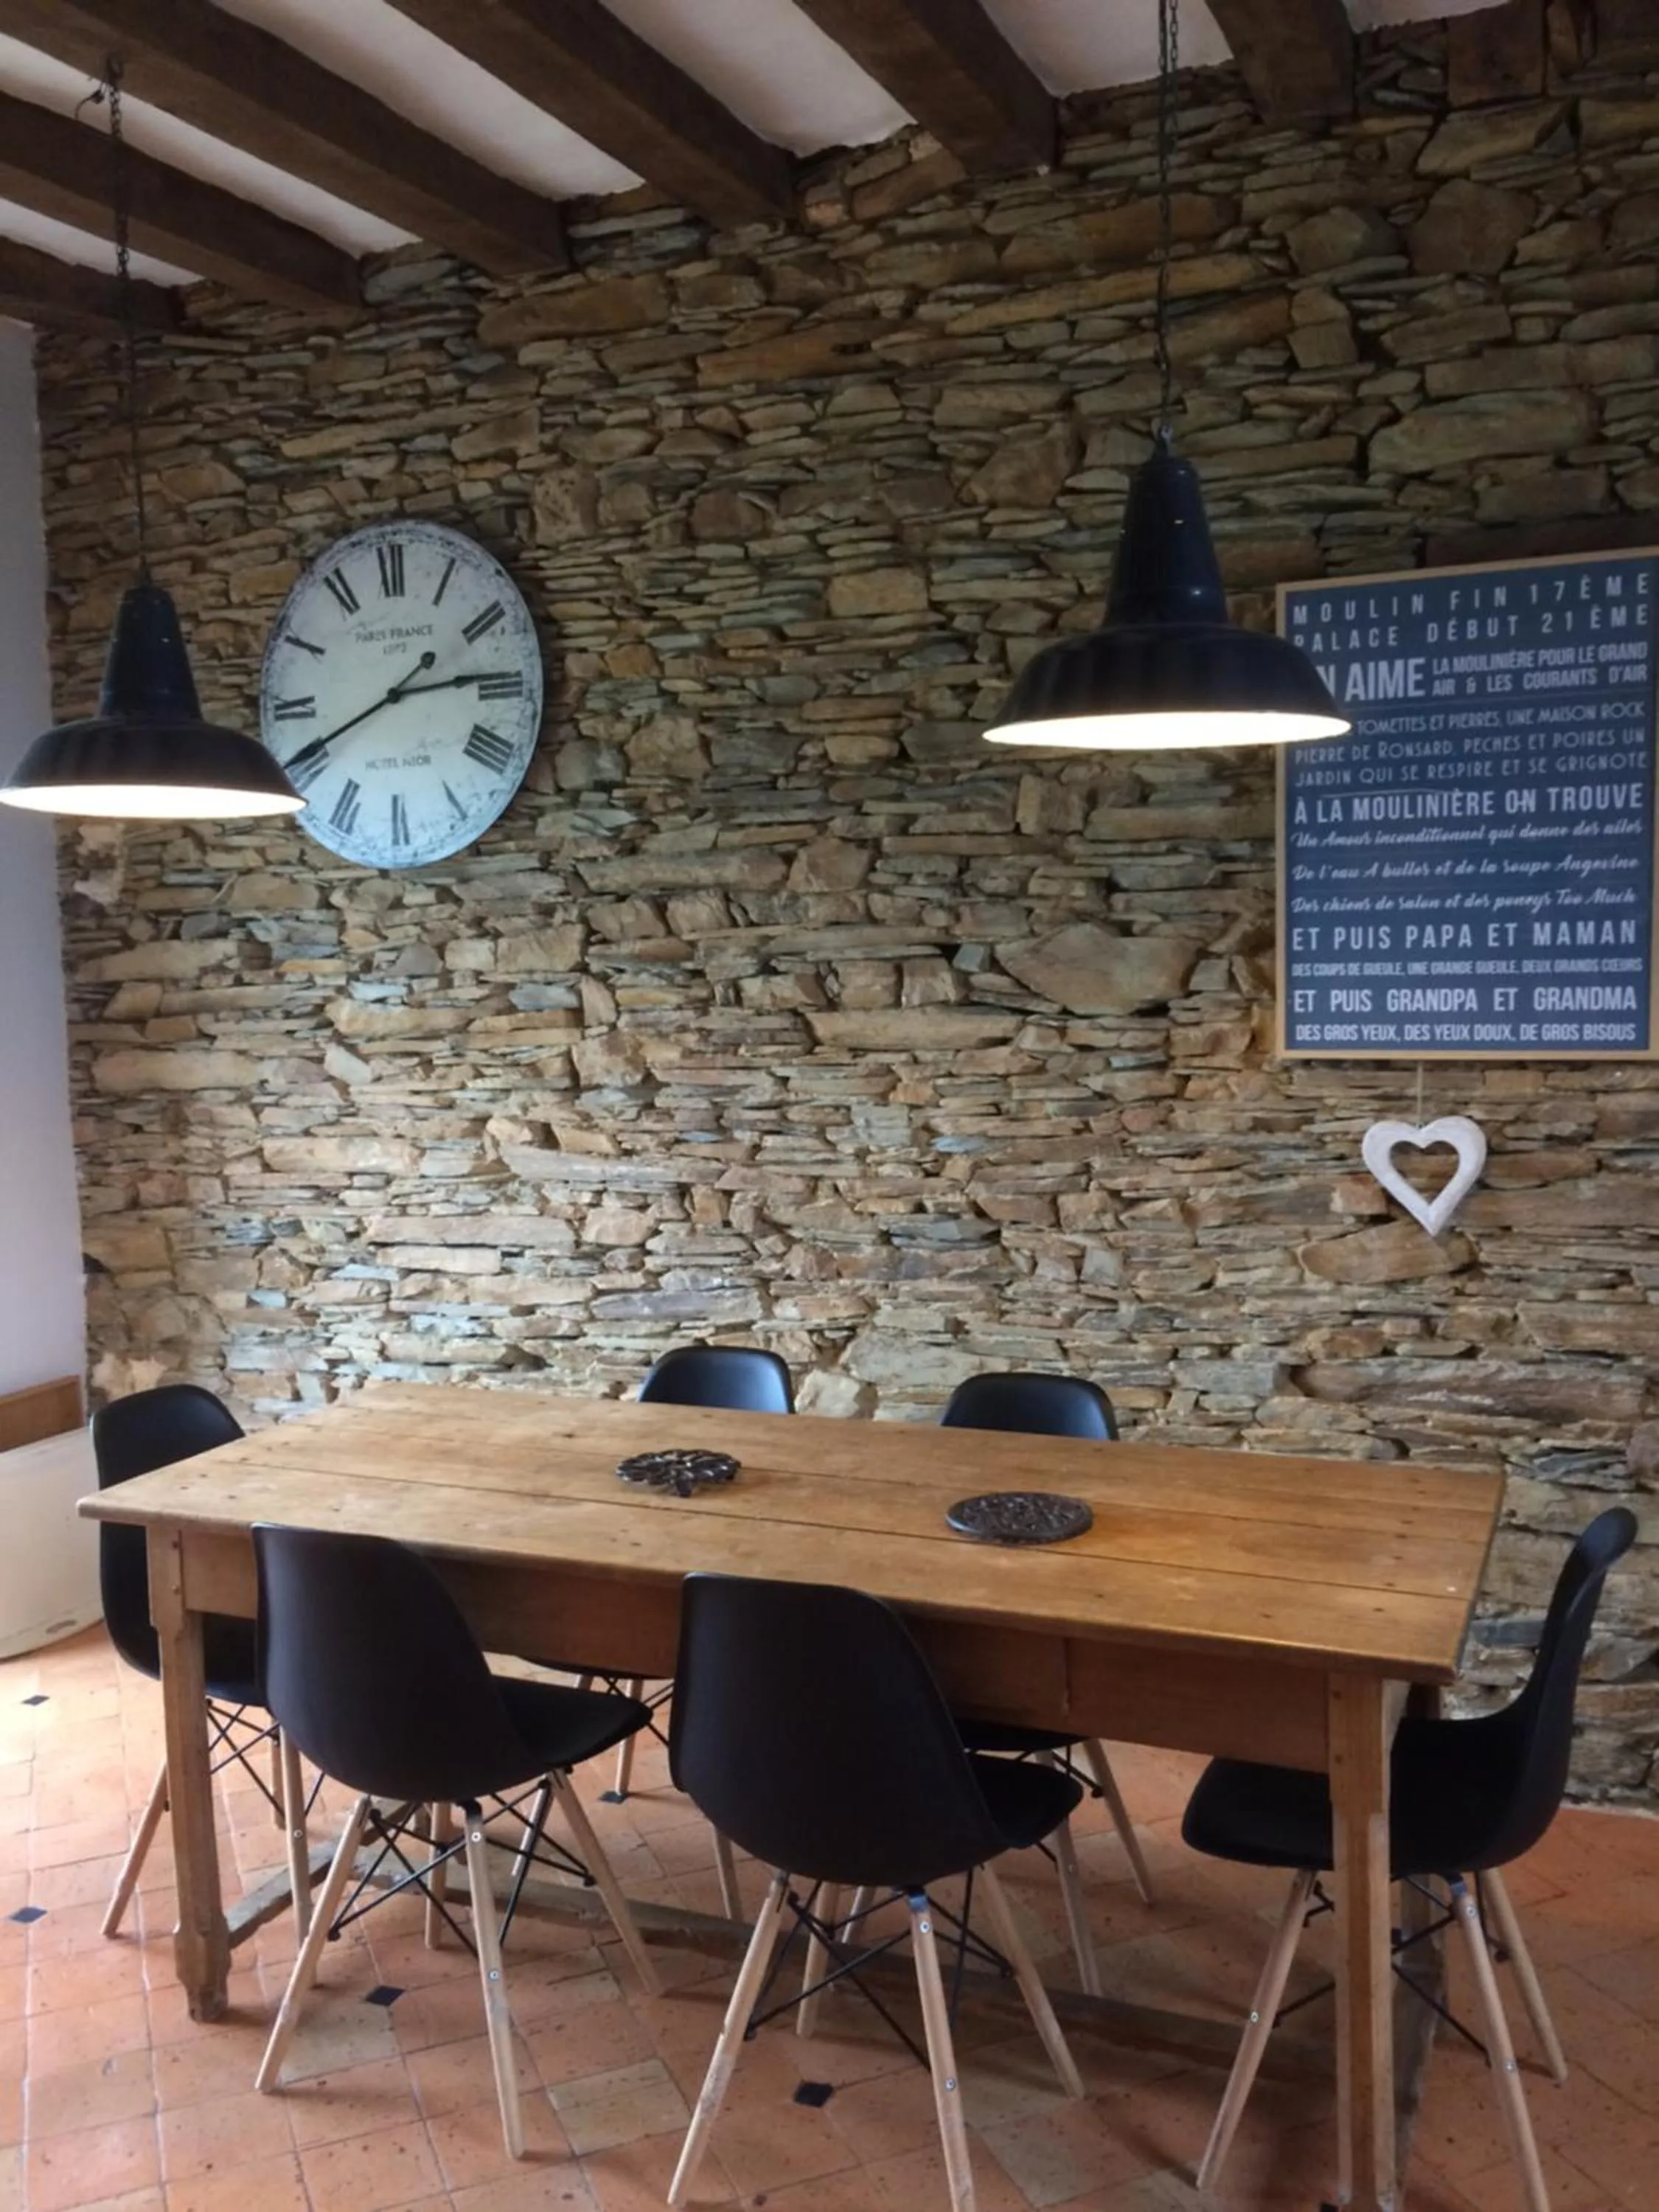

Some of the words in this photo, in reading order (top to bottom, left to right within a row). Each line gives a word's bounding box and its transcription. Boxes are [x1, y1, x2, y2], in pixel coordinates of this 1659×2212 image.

[1293, 593, 1424, 625] MOULIN
[1450, 586, 1506, 611] FIN
[1295, 625, 1399, 653] PALACE
[1427, 615, 1518, 643] DÉBUT
[1433, 657, 1450, 675] LA
[1538, 647, 1576, 667] POUR
[1579, 645, 1596, 664] LE
[1598, 641, 1648, 662] GRAND
[1344, 658, 1426, 702] AIME
[1433, 678, 1455, 696] AIR
[1466, 676, 1477, 695] &
[1486, 673, 1512, 692] LES
[1523, 667, 1598, 690] COURANTS
[1608, 664, 1648, 684] D'AIR
[1357, 716, 1427, 734] TOMETTES
[1430, 714, 1445, 731] ET
[1506, 708, 1534, 726] UNE
[1537, 706, 1596, 723] MAISON
[1601, 701, 1646, 720] ROCK
[1295, 746, 1346, 765] PIERRE
[1352, 744, 1371, 762] DE
[1528, 733, 1546, 751] ET
[1552, 729, 1616, 748] POIRES
[1623, 727, 1645, 745] UN
[1295, 769, 1352, 787] JARDIN
[1359, 765, 1393, 785] QUI
[1402, 764, 1420, 782] SE
[1427, 760, 1493, 779] RESPIRE
[1501, 759, 1520, 776] ET
[1528, 757, 1548, 775] SE
[1555, 751, 1648, 773] GRIGNOTE
[1294, 796, 1308, 824] À
[1316, 799, 1343, 824] LA
[1352, 787, 1495, 822] MOULINIÈRE
[1505, 788, 1537, 815] ON
[1545, 782, 1644, 812] TROUVE
[1290, 832, 1318, 848] Un
[1319, 830, 1372, 847] Amour
[1374, 824, 1486, 845] inconditionnel
[1487, 824, 1517, 846] qui
[1519, 822, 1569, 839] donne
[1572, 819, 1601, 836] des
[1291, 863, 1315, 881] De
[1381, 861, 1430, 878] bulles
[1434, 859, 1454, 877] et
[1454, 858, 1475, 875] de
[1479, 858, 1498, 874] la
[1501, 858, 1552, 877] soupe
[1554, 854, 1641, 879] Angevine
[1290, 896, 1320, 914] Des
[1323, 895, 1371, 912] chiens
[1374, 895, 1396, 911] de
[1398, 894, 1441, 911] salon
[1444, 892, 1463, 909] et
[1464, 892, 1491, 908] des
[1556, 888, 1583, 905] Too
[1584, 887, 1638, 905] Much
[1292, 927, 1321, 951] ET
[1333, 925, 1391, 951] PUIS
[1405, 923, 1472, 950] PAPA
[1487, 923, 1518, 947] ET
[1533, 919, 1636, 947] MAMAN
[1291, 963, 1312, 977] DES
[1312, 962, 1346, 977] COUPS
[1347, 961, 1361, 976] DE
[1407, 960, 1429, 975] UNE
[1430, 960, 1473, 975] GRANDE
[1521, 959, 1552, 974] DEUX
[1554, 958, 1599, 973] GRANDS
[1293, 989, 1318, 1013] ET
[1329, 988, 1374, 1013] PUIS
[1386, 987, 1479, 1013] GRANDPA
[1493, 987, 1519, 1012] ET
[1533, 985, 1638, 1012] GRANDMA
[1295, 1023, 1321, 1041] DES
[1323, 1023, 1359, 1041] GROS
[1403, 1023, 1431, 1041] DES
[1433, 1023, 1471, 1041] YEUX
[1519, 1023, 1540, 1041] DE
[1540, 1023, 1580, 1041] GROS
[1582, 1023, 1637, 1041] BISOUS
